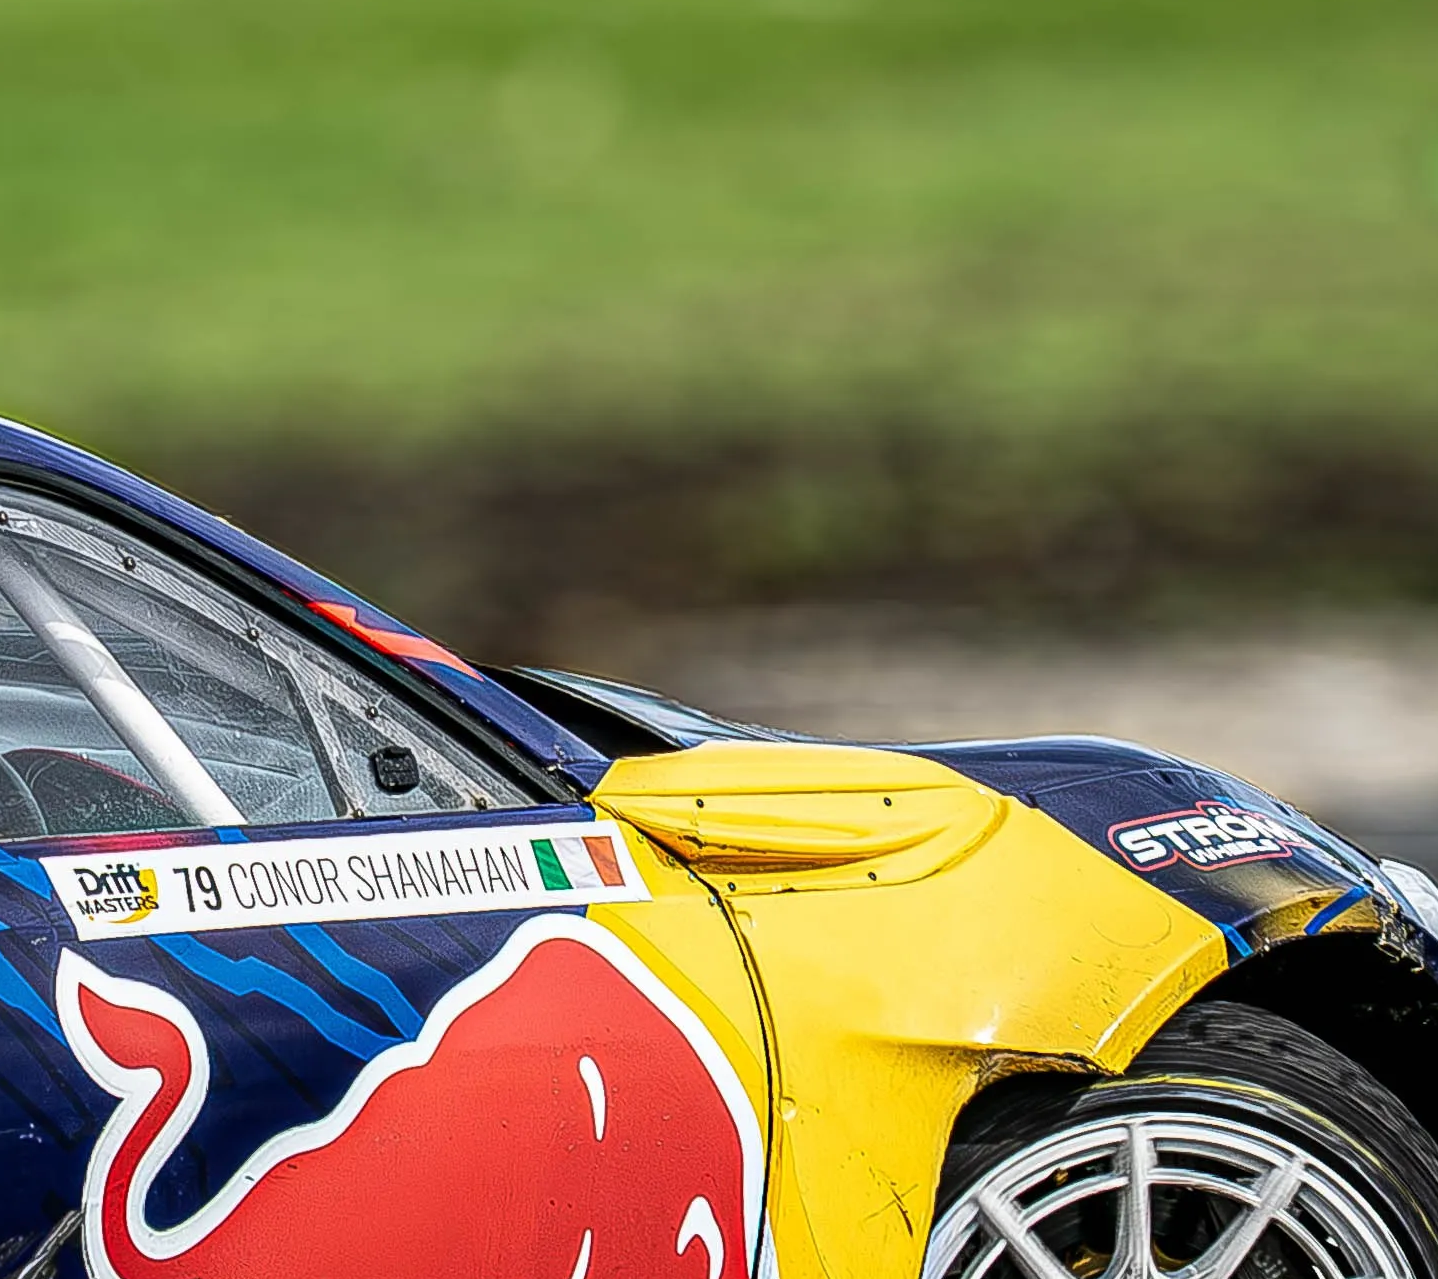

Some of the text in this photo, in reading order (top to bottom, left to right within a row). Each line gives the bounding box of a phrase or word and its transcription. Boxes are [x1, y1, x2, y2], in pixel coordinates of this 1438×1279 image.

[1120, 807, 1304, 864] STRÖM
[1187, 838, 1281, 864] WHEELS
[72, 862, 150, 897] Drift
[172, 844, 529, 913] 79 CONOR SHANAHAN
[75, 895, 160, 916] MASTERS
